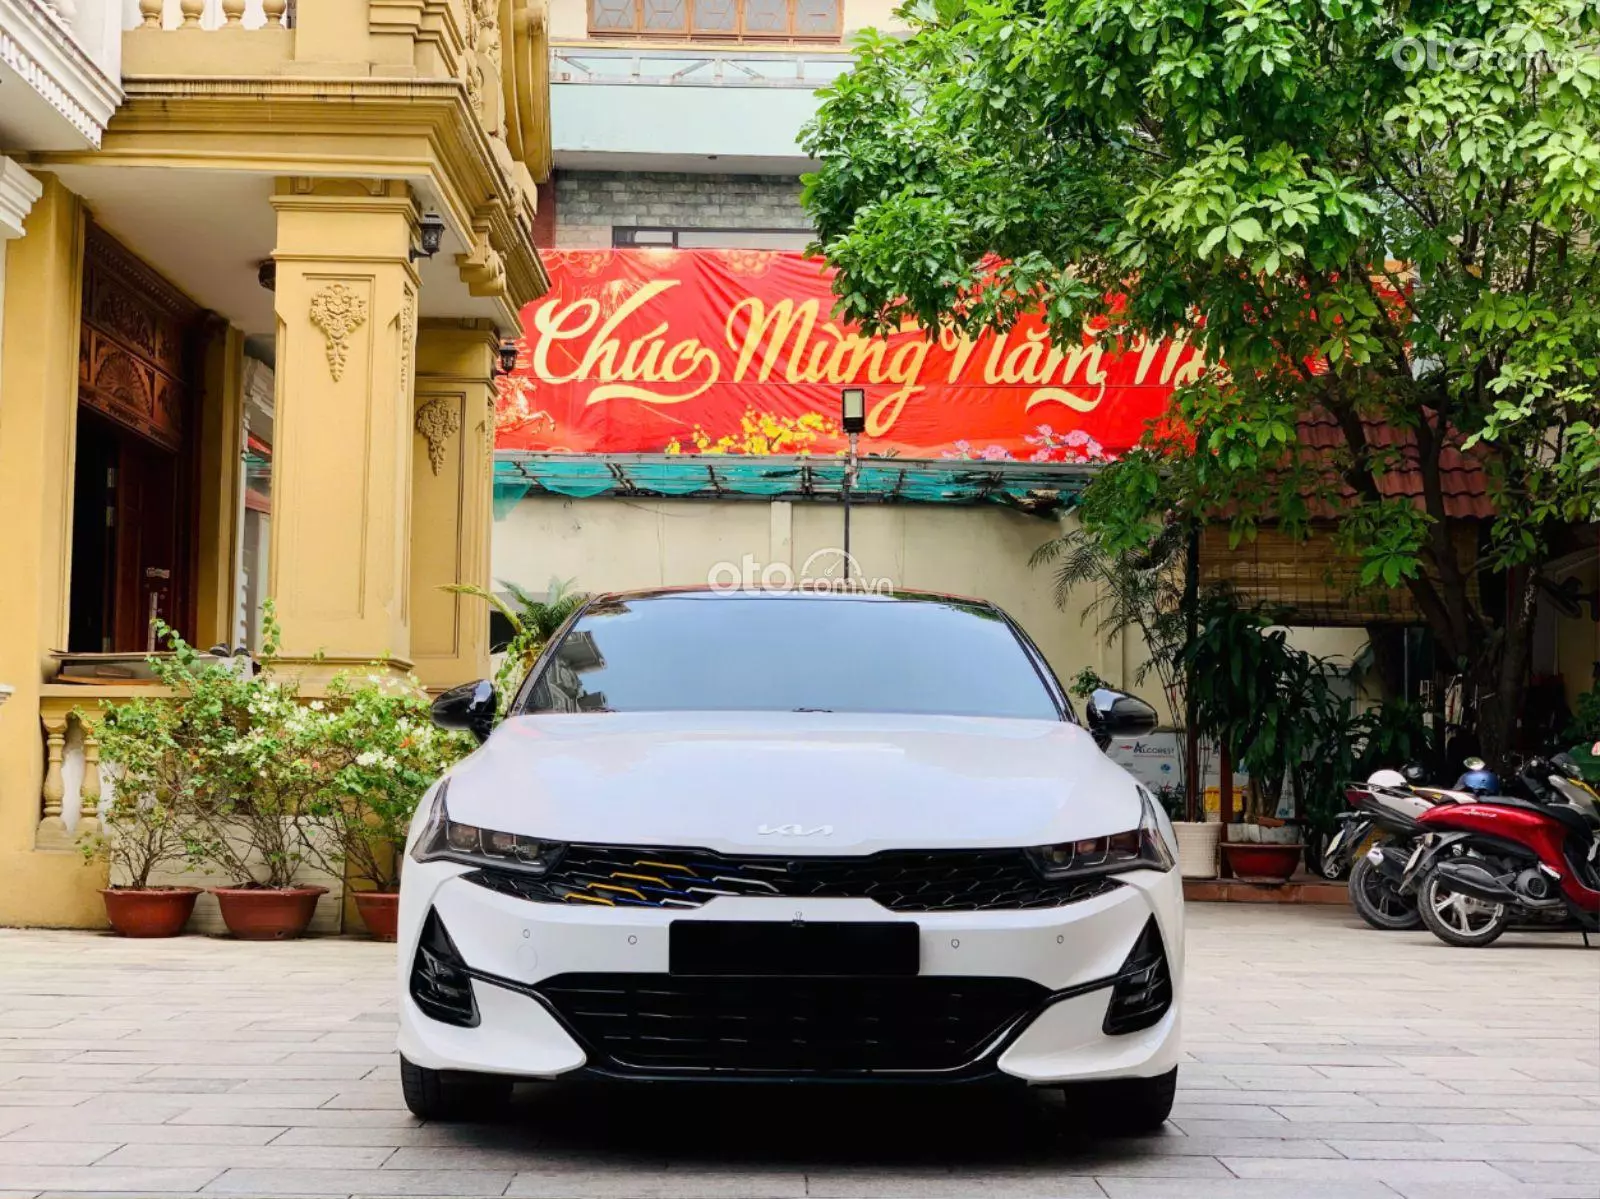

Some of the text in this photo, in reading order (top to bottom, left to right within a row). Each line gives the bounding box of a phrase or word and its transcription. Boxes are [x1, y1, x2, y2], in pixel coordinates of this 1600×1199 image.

[533, 279, 721, 405] Chúc
[726, 297, 933, 438] Mừng
[939, 314, 1108, 414] Năm
